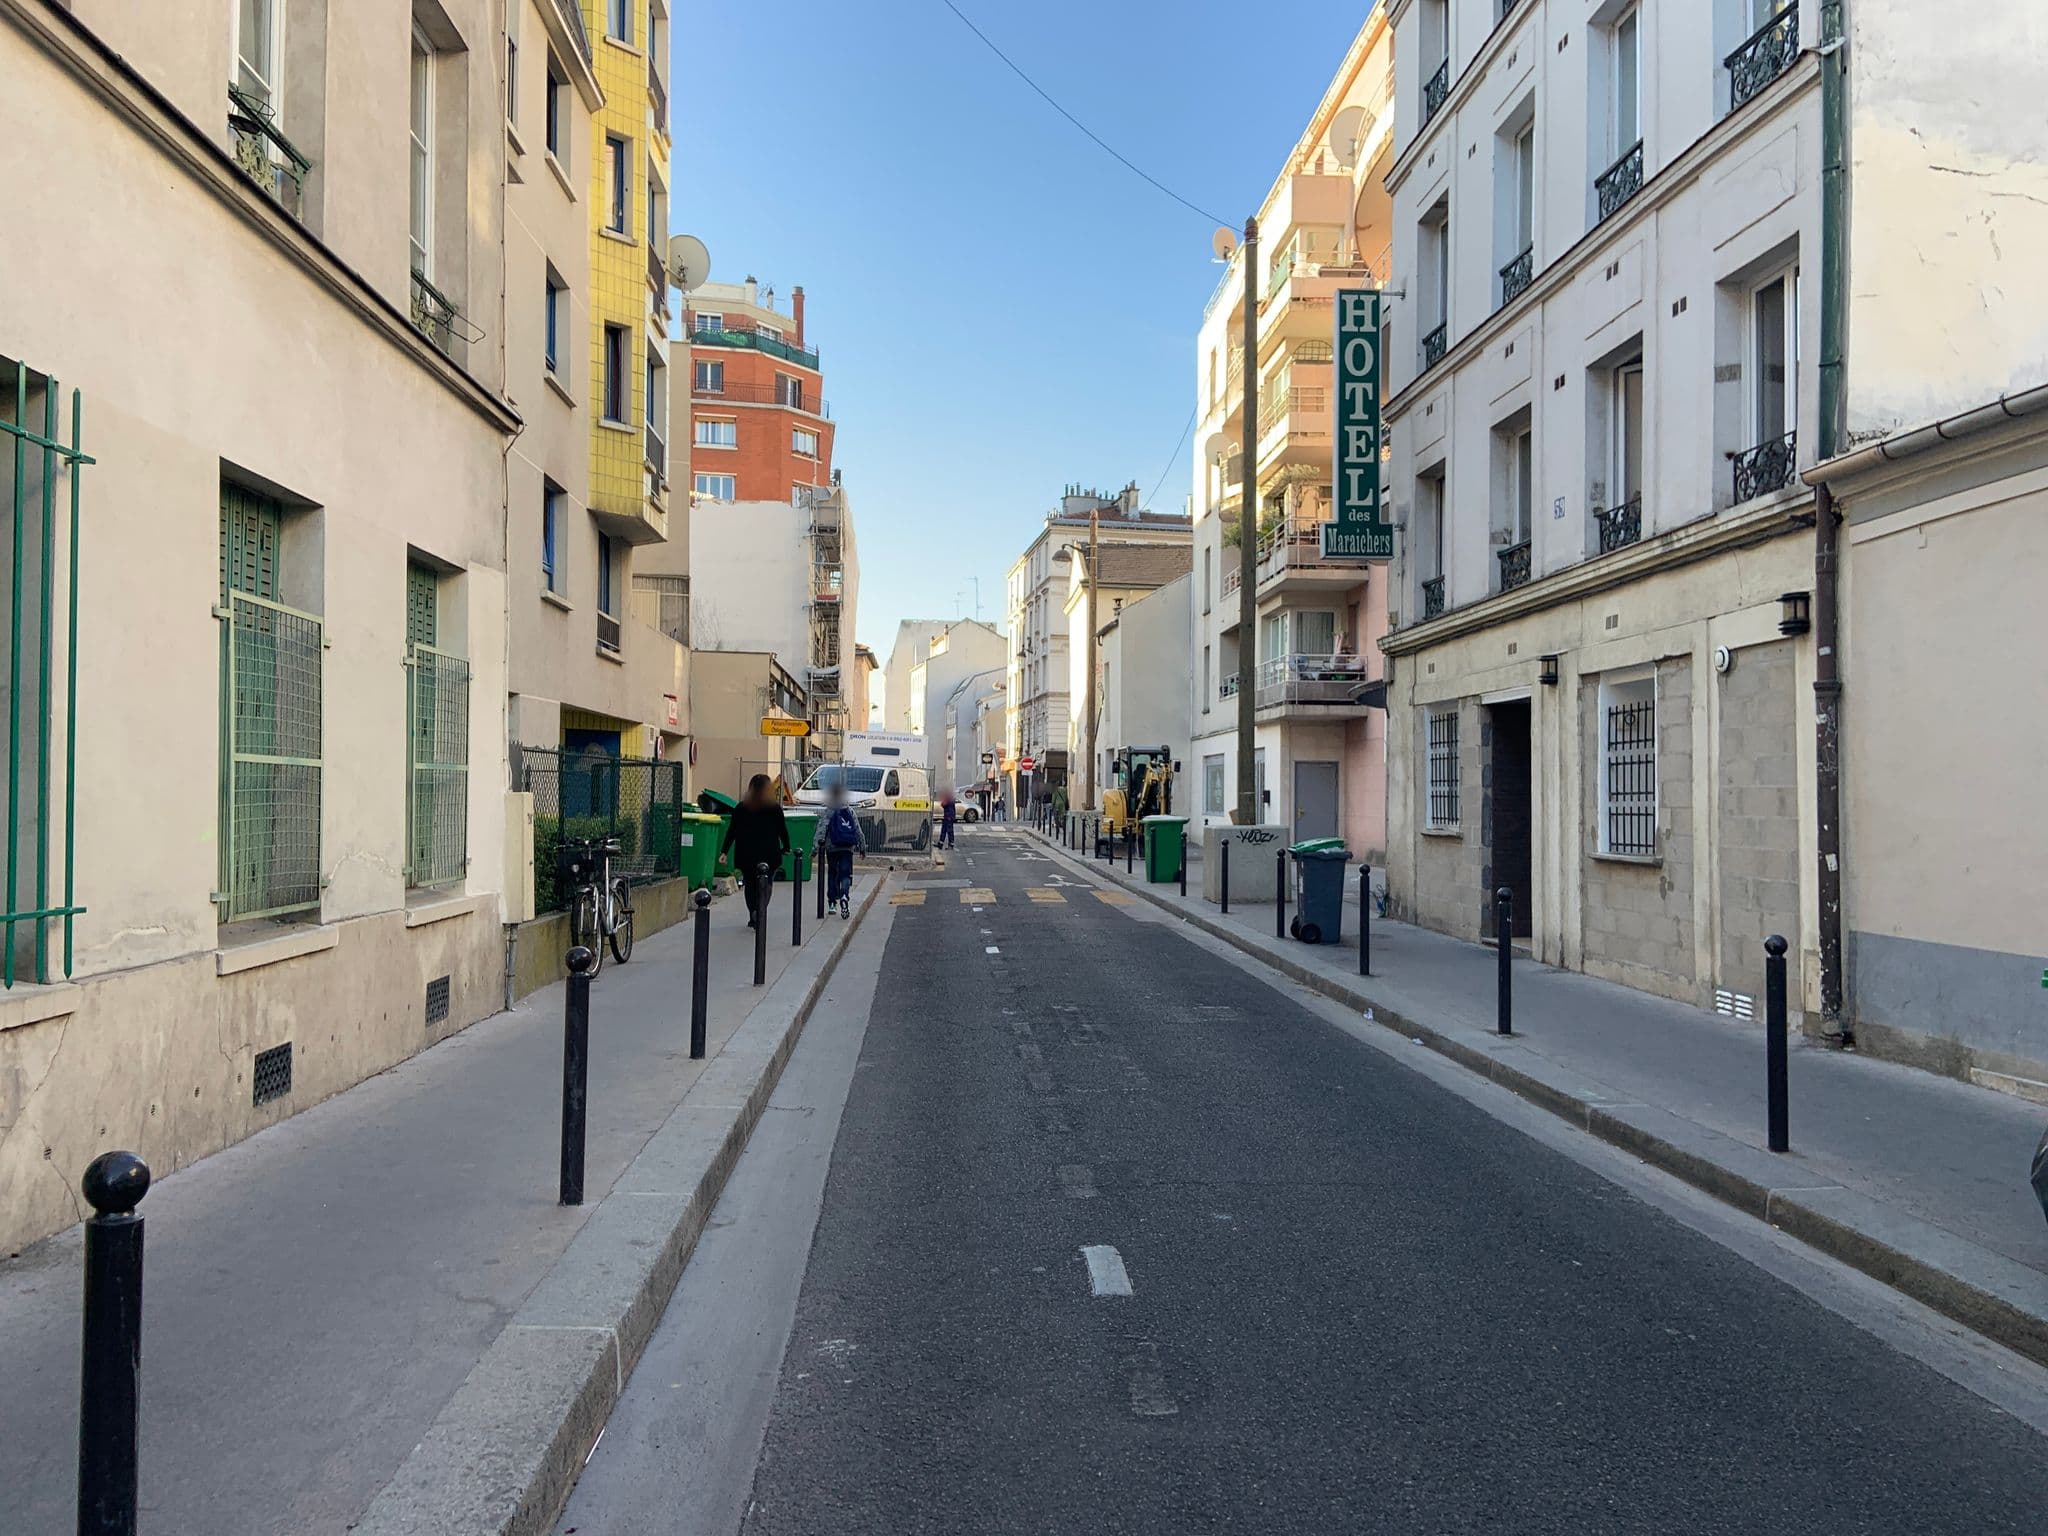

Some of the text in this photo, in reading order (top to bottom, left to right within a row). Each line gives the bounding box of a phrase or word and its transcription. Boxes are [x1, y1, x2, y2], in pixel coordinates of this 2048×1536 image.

[1341, 294, 1377, 506] HOTEL
[1348, 508, 1371, 521] des
[1327, 528, 1391, 554] Maraichers
